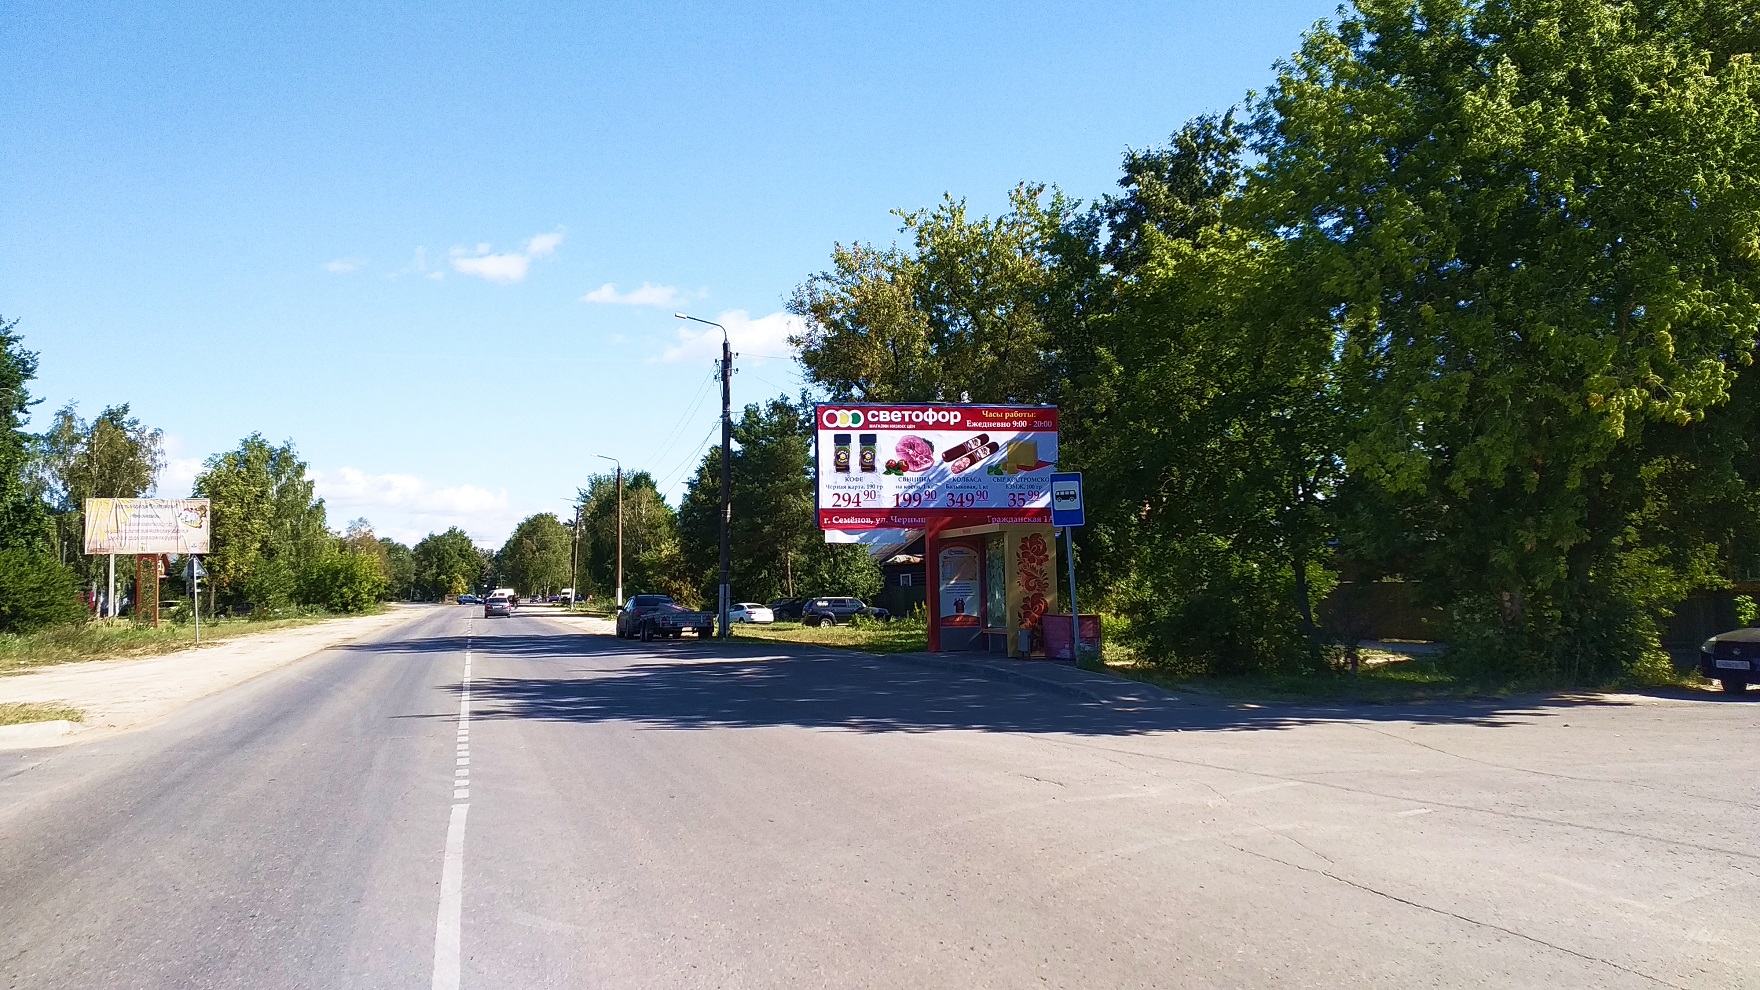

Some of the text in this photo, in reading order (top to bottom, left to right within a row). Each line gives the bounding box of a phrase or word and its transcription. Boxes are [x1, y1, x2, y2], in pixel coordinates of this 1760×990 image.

[867, 408, 961, 425] светофор
[966, 419, 1011, 428] Ежедневно
[1012, 420, 1027, 428] 9:00
[1033, 420, 1053, 428] 20:00
[982, 410, 1037, 419] Часы работы:
[832, 489, 877, 508] 294 90
[893, 489, 937, 508] 199 90
[946, 489, 989, 508] 349 90
[1007, 489, 1041, 508] 35 99
[832, 515, 874, 525] Семёнов,
[875, 516, 889, 525] ул.
[890, 515, 926, 525] Черныш
[986, 514, 1042, 524] Гражданская
